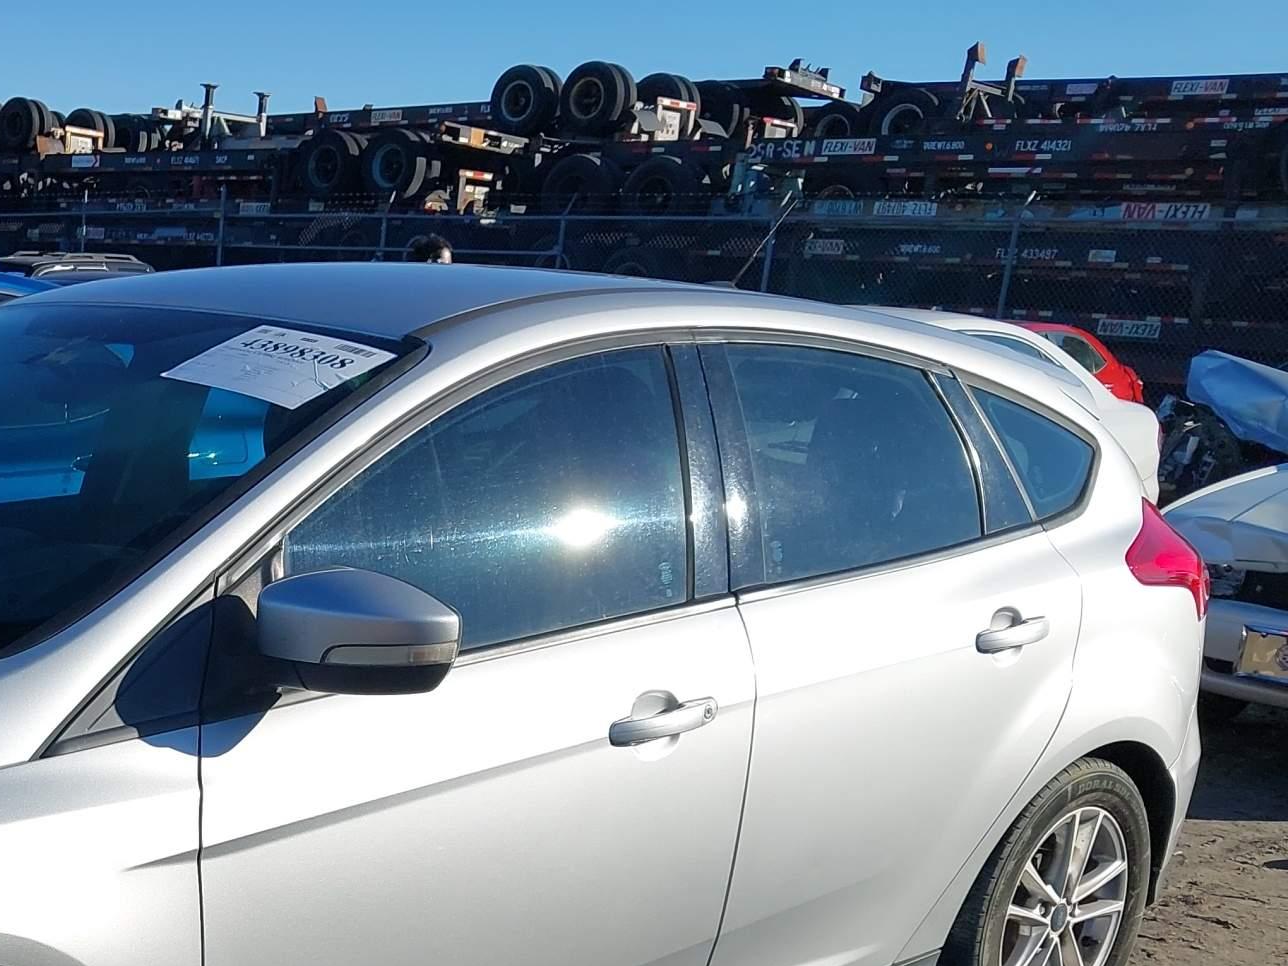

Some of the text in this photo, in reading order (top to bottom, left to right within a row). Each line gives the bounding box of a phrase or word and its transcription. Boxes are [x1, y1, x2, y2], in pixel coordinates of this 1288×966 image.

[1173, 79, 1227, 95] FLEXI-VAN
[824, 139, 875, 152] FLEXI-VAN
[1040, 140, 1072, 151] 414321
[1123, 203, 1207, 219] FLEXI-VAN
[1101, 320, 1159, 337] FLEXI-VAN
[240, 338, 354, 369] 43898308
